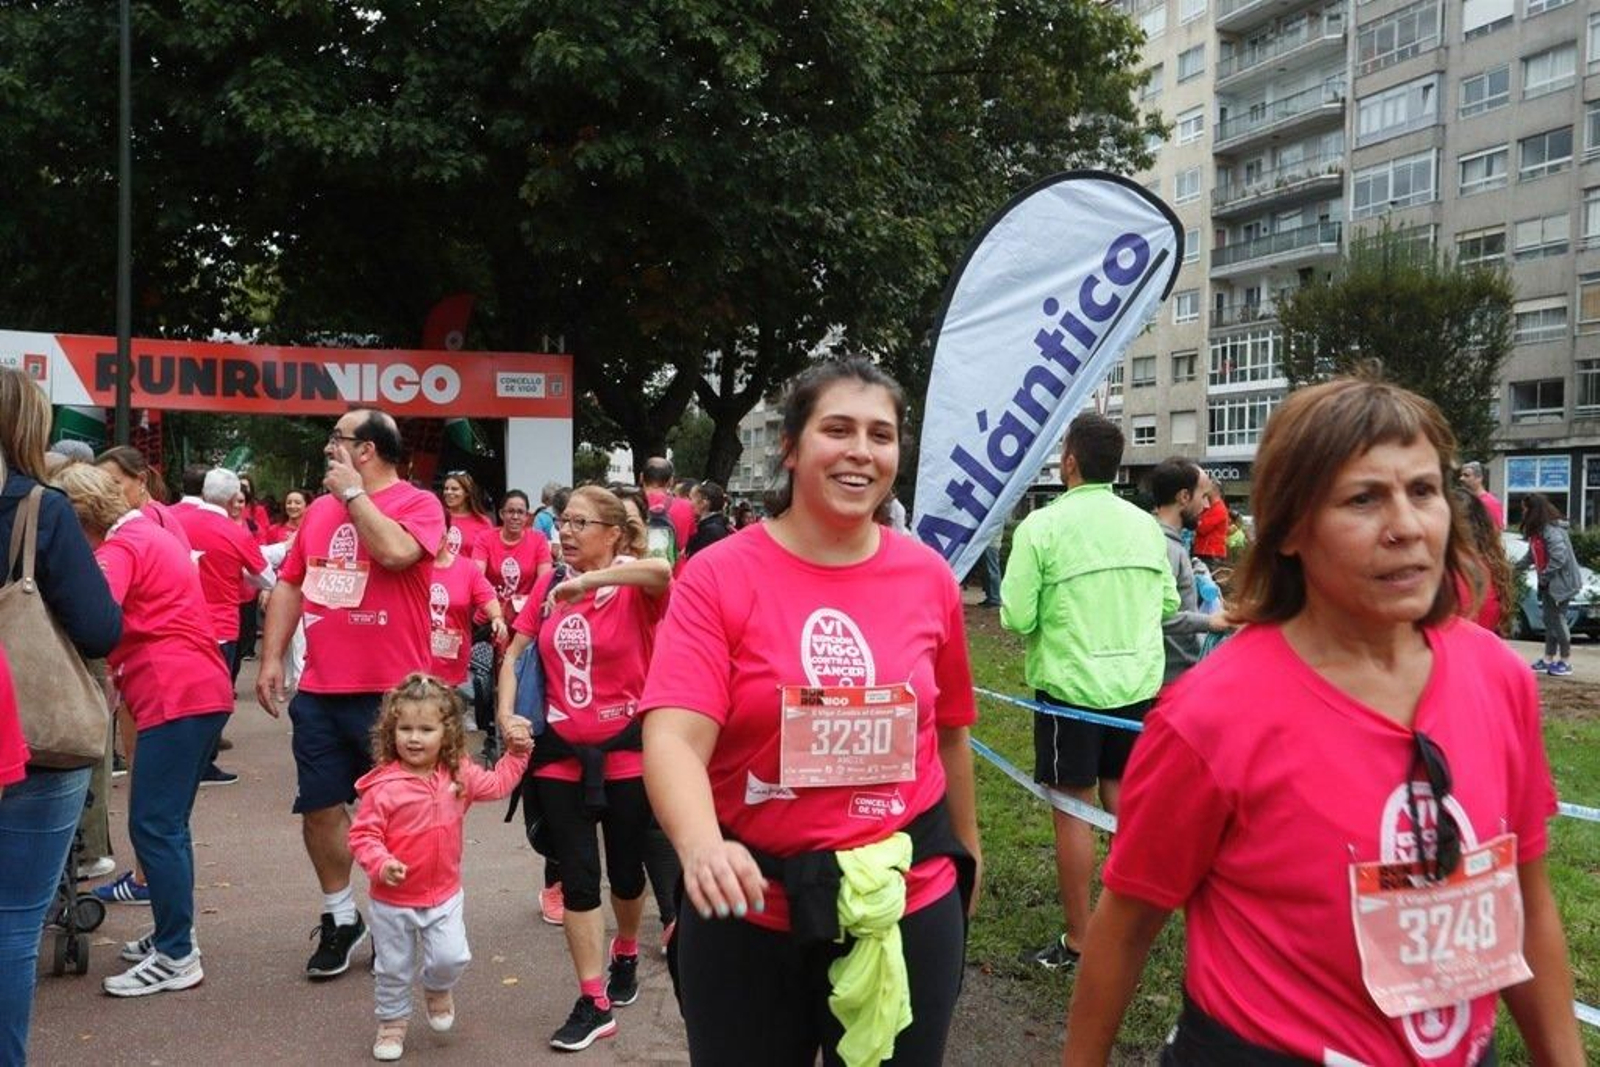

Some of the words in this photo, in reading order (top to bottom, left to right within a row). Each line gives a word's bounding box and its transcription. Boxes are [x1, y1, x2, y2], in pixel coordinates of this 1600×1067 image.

[917, 232, 1150, 560] Atlántico
[318, 573, 355, 593] 4353
[818, 618, 843, 636] VI
[812, 642, 860, 657] VIGO
[811, 718, 893, 755] 3230
[854, 797, 890, 808] CONCELL
[1399, 892, 1497, 965] 3248
